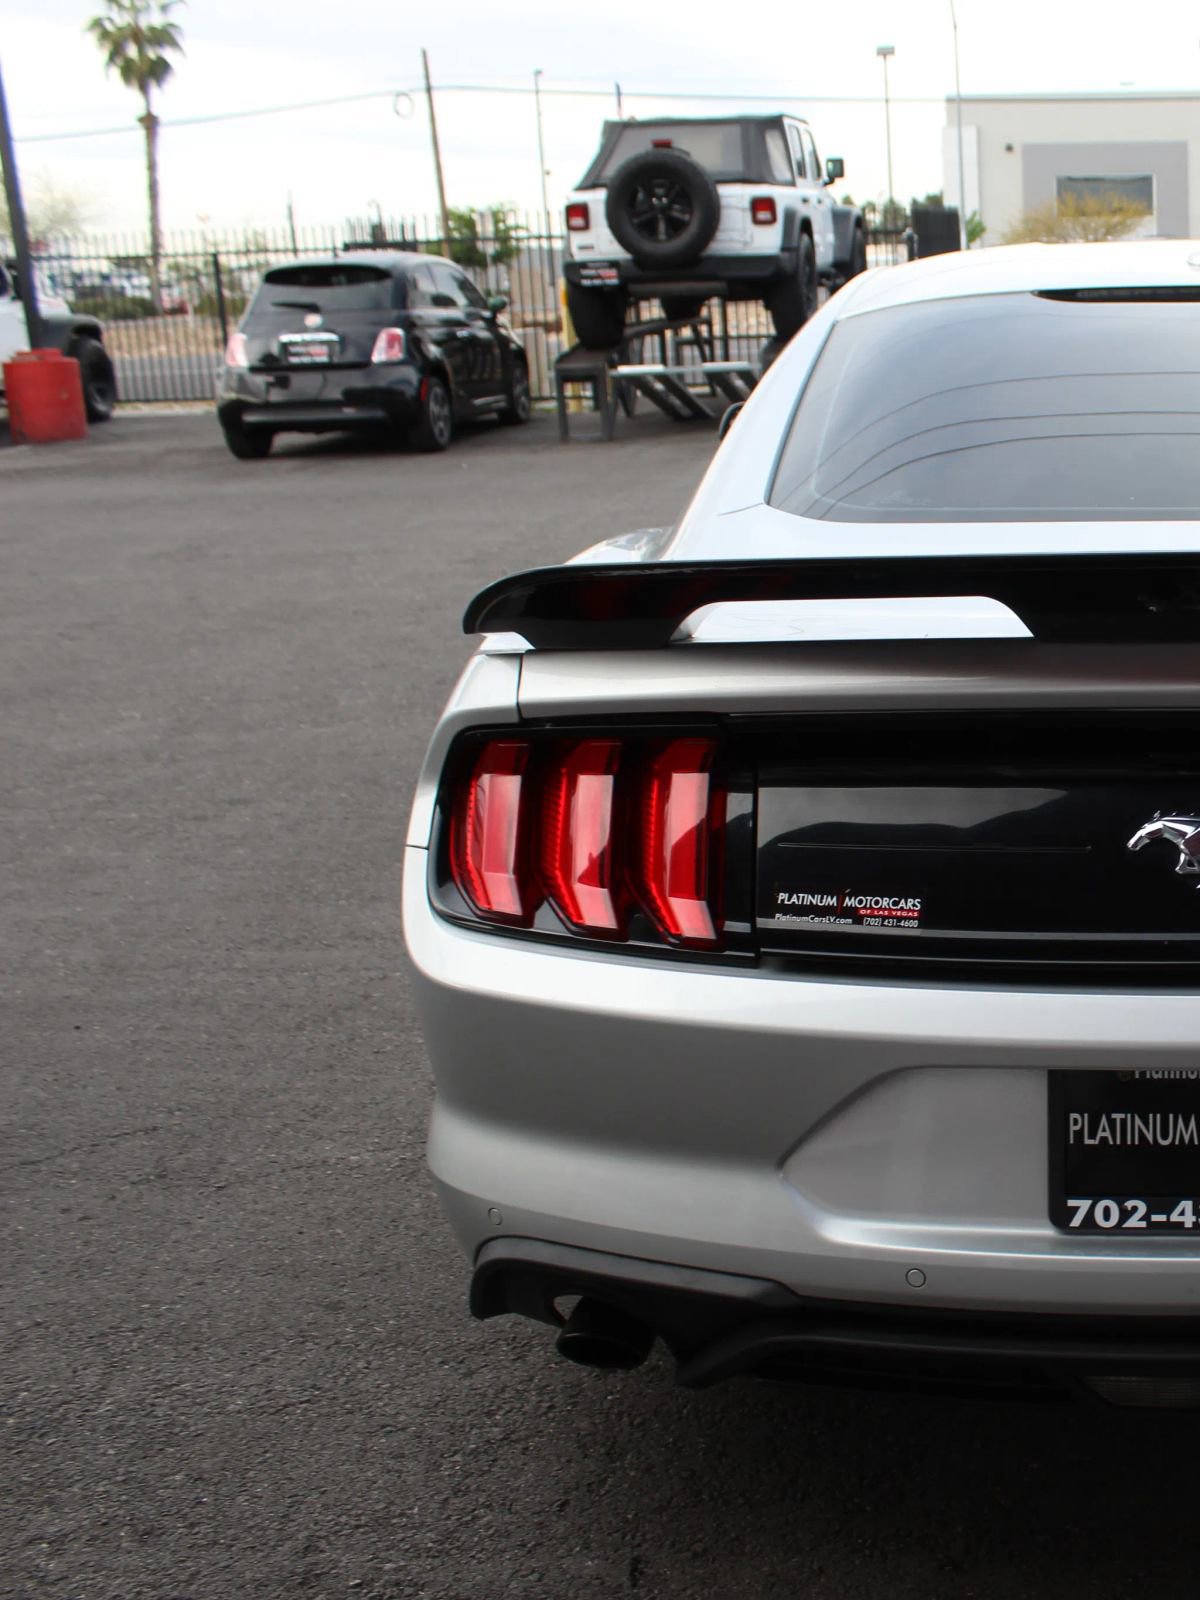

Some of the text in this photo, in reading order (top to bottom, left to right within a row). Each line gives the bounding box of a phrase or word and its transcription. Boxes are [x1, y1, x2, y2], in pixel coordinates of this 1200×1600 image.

[777, 892, 921, 911] PLATINUM MOTORCARS
[775, 914, 853, 924] PlatinumCarsLV.com
[863, 917, 919, 928] (702) 431-4600
[1069, 1112, 1199, 1146] PLATINUM
